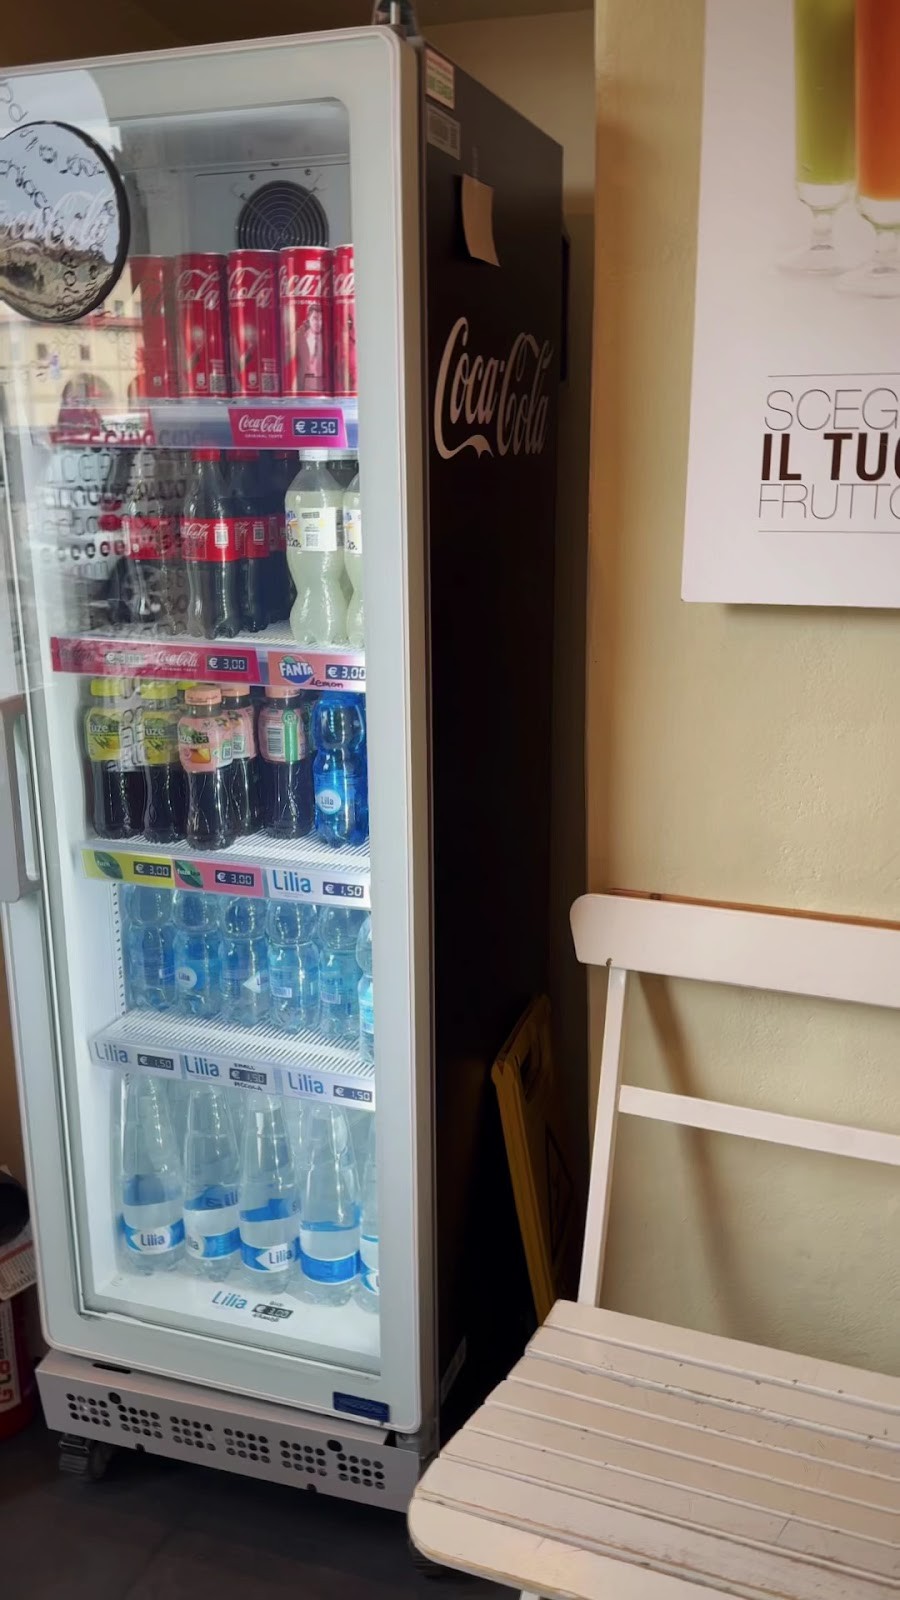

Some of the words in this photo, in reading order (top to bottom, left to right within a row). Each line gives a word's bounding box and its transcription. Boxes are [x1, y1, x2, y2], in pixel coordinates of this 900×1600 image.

[433, 316, 553, 460] Coca-Cola
[238, 414, 287, 433] Coca-Cola
[761, 433, 802, 481] IL
[823, 432, 900, 482] TU
[758, 483, 900, 520] FRUTT
[280, 663, 314, 677] FANTA
[272, 869, 312, 893] Lilia
[94, 1042, 129, 1063] Lilia
[184, 1055, 220, 1077] Lilia
[287, 1072, 324, 1094] Lilia
[140, 1233, 166, 1247] Lilia
[211, 1290, 248, 1309] Lilia
